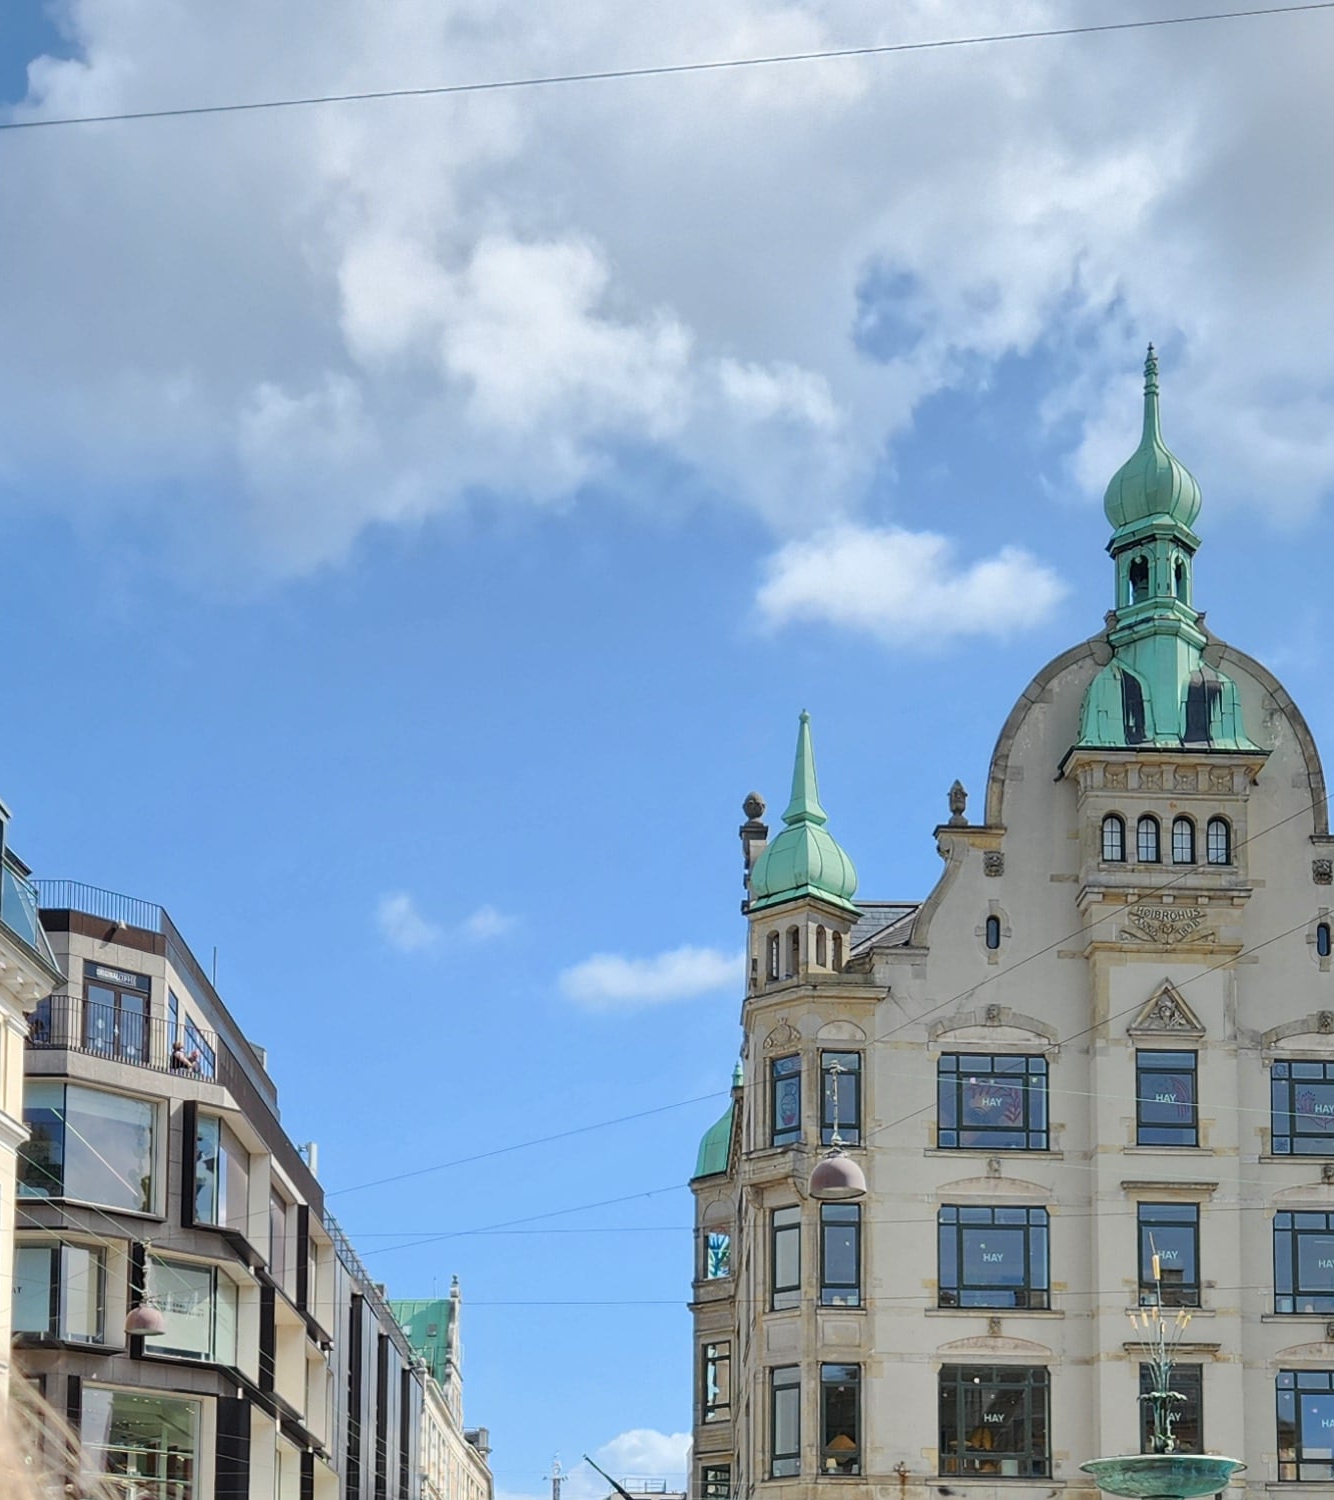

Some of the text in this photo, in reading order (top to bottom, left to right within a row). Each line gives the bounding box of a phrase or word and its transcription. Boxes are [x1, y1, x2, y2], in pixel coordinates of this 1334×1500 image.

[982, 1097, 1003, 1108] HAY
[1155, 1093, 1176, 1103] HAY
[983, 1253, 1004, 1263] HAY
[1158, 1251, 1178, 1260] HAY
[984, 1414, 1005, 1424] HAY
